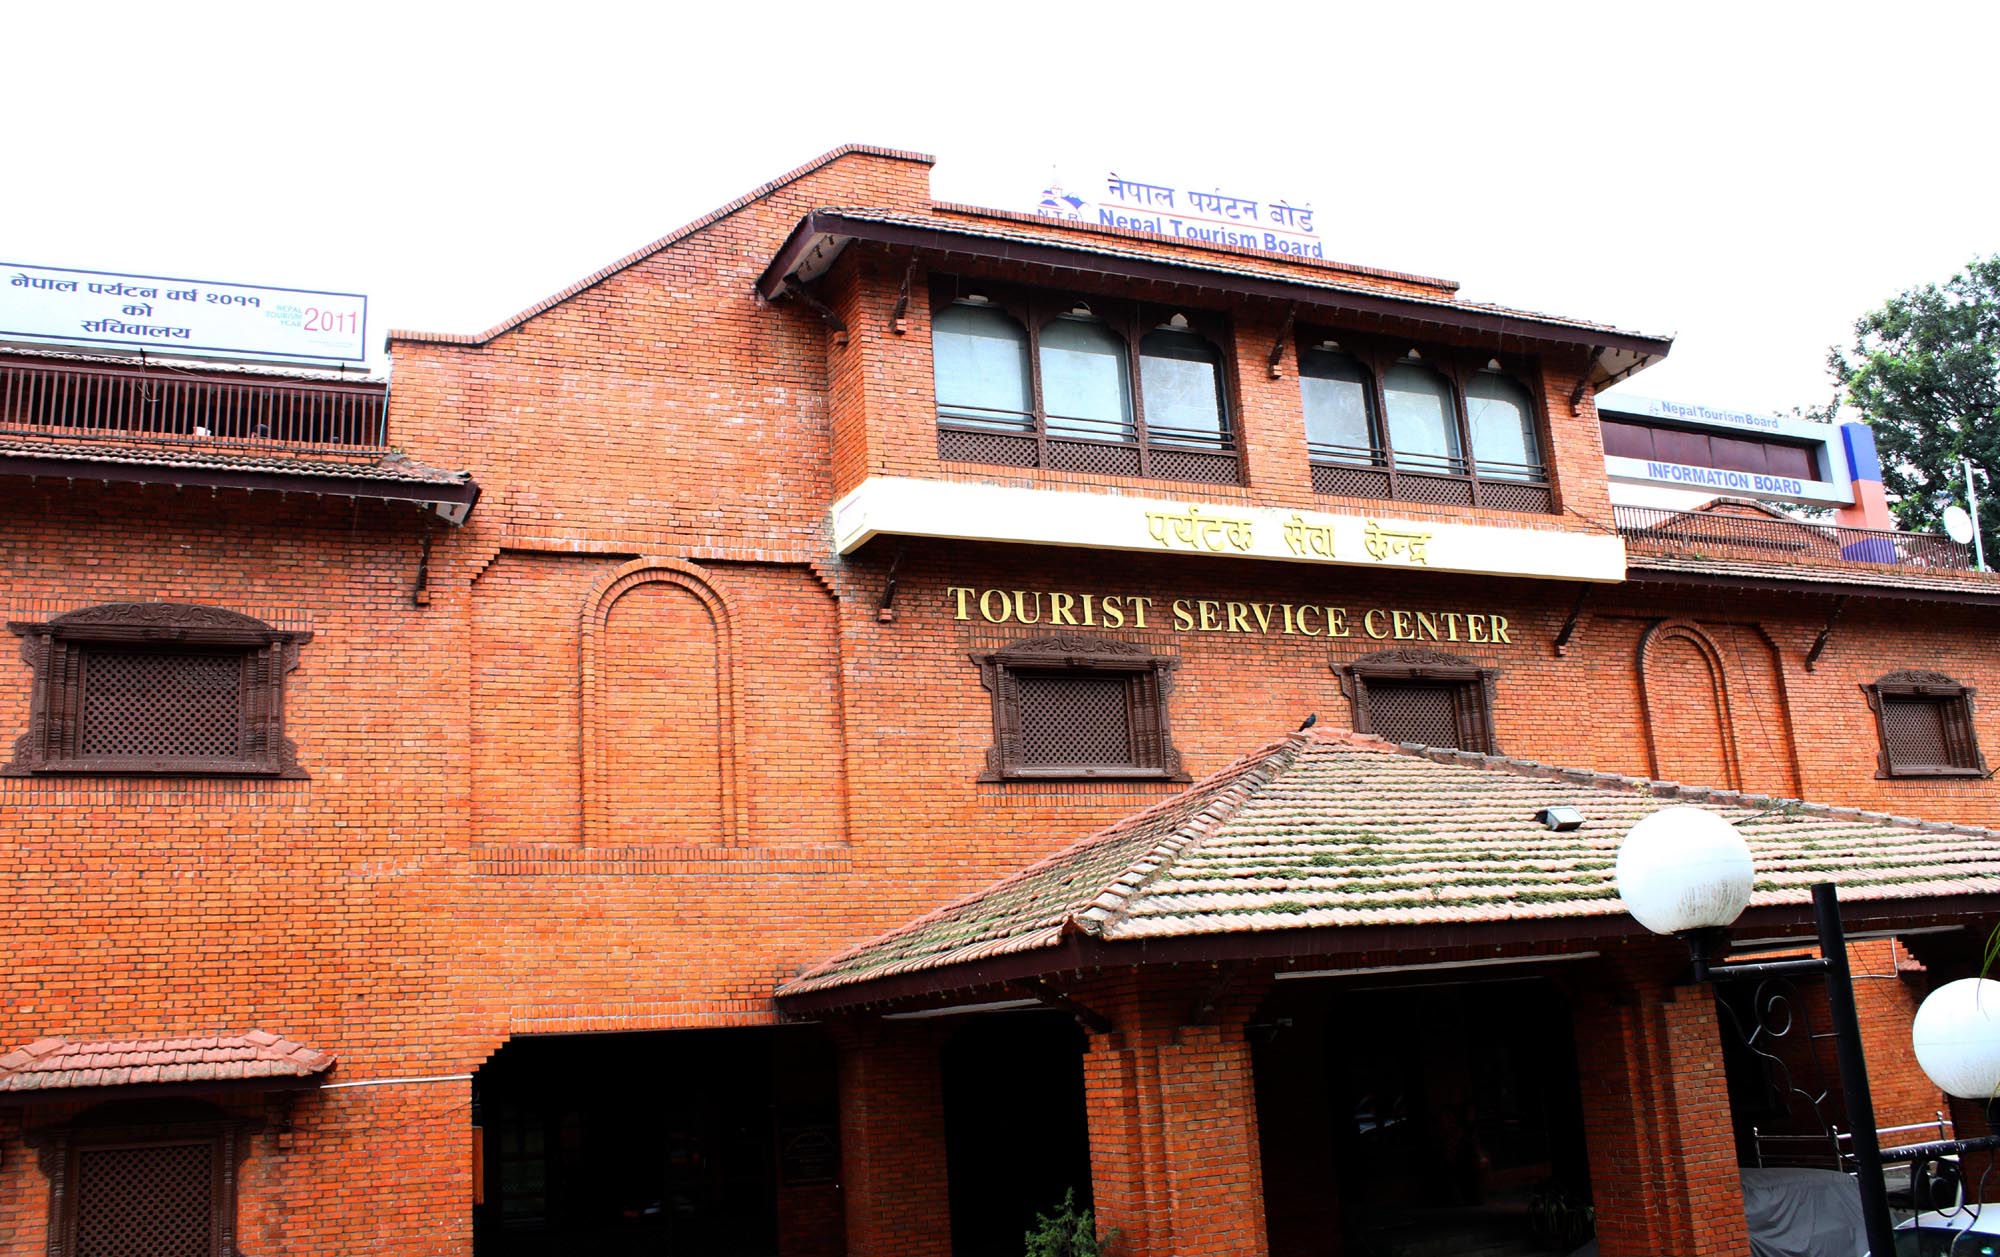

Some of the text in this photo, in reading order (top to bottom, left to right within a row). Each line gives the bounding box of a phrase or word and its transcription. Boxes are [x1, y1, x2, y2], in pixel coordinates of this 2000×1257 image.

[1107, 172, 1314, 232] नेपाल पर्यटन बोर्ड
[1099, 208, 1323, 258] Nepal Tourism Board
[10, 273, 261, 308] नेपाल पर्यटन वर्ष २०११
[122, 303, 153, 317] को
[304, 307, 357, 334] 2011
[81, 319, 192, 339] सचिवालय
[1662, 401, 1779, 428] Nepal Tourism Board
[1647, 462, 1802, 496] INFORMATION BOARD
[1146, 505, 1432, 565] पर्यटक सेवा केन्द्र
[947, 586, 1512, 645] TOURIST SERVICE CENTER
